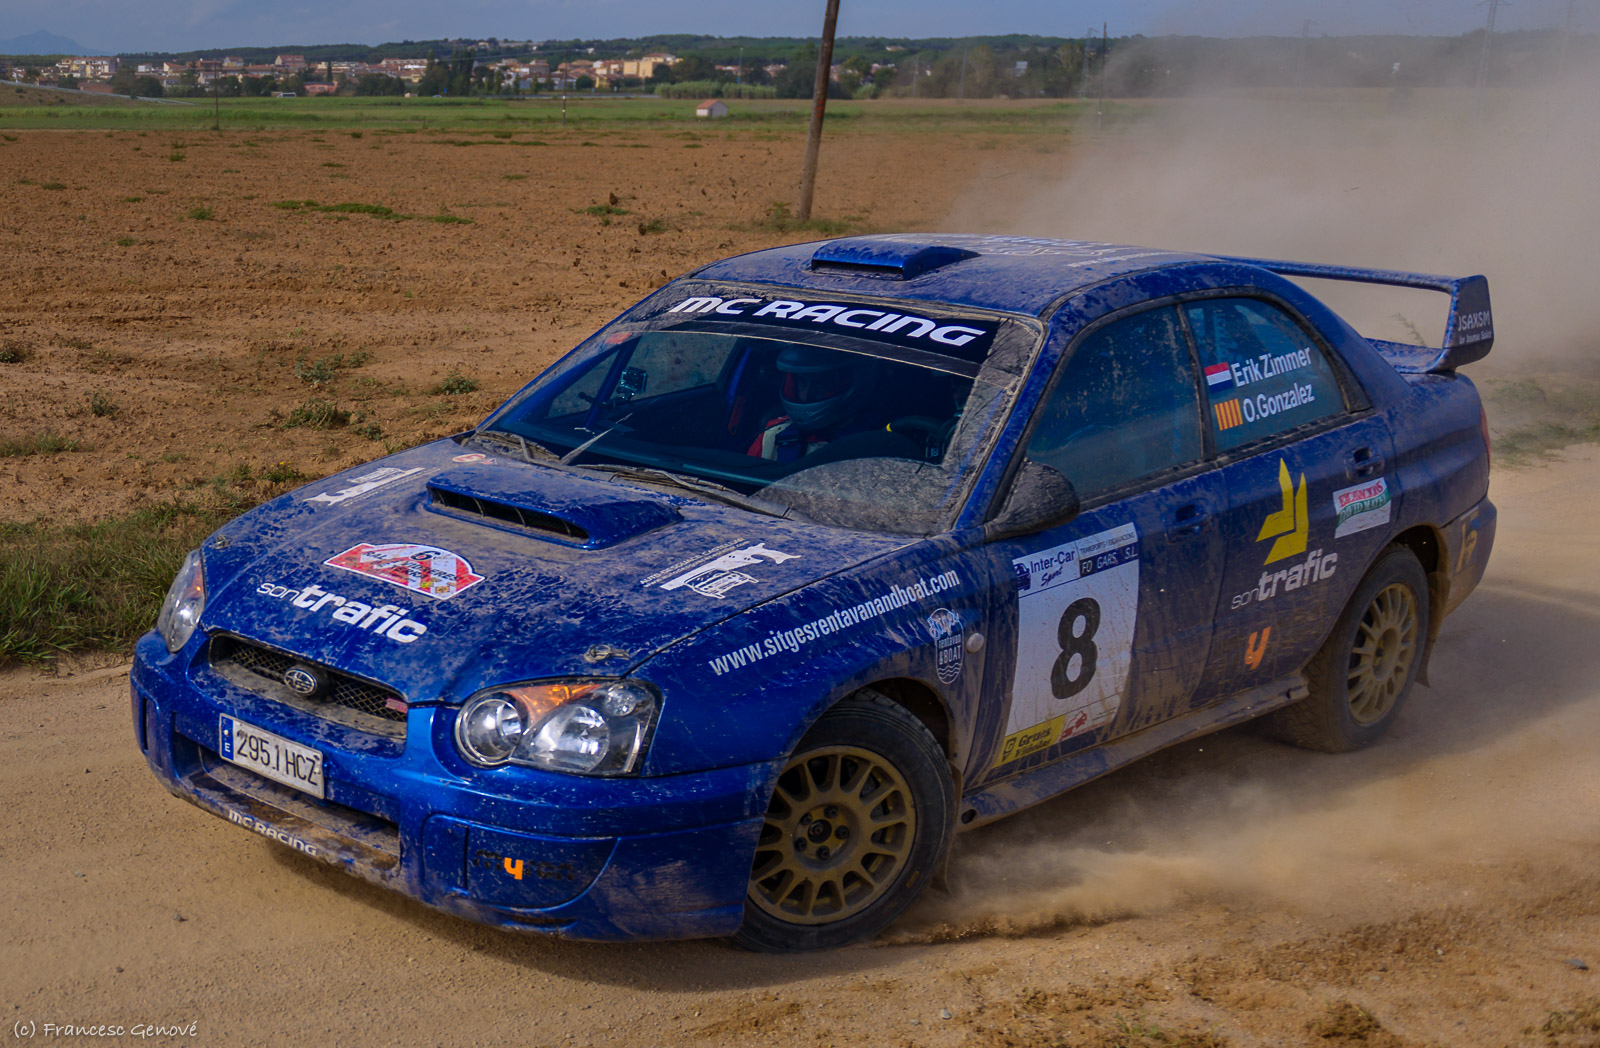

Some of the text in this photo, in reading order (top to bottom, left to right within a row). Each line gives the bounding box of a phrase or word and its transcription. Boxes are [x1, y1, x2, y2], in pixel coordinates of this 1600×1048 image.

[668, 297, 987, 347] MC RACING
[1231, 347, 1312, 387] Erik Zimmer
[1242, 382, 1315, 423] O.Gonzalez
[1030, 550, 1075, 574] Inter-Car
[1231, 549, 1338, 610] sontrafic
[257, 581, 427, 643] sontrafic
[708, 569, 960, 676] www.sitgesrentavanandboat.com
[1050, 597, 1101, 700] 8
[224, 742, 231, 753] E
[236, 729, 319, 787] 2951 HCZ
[228, 809, 317, 856] MC RACING
